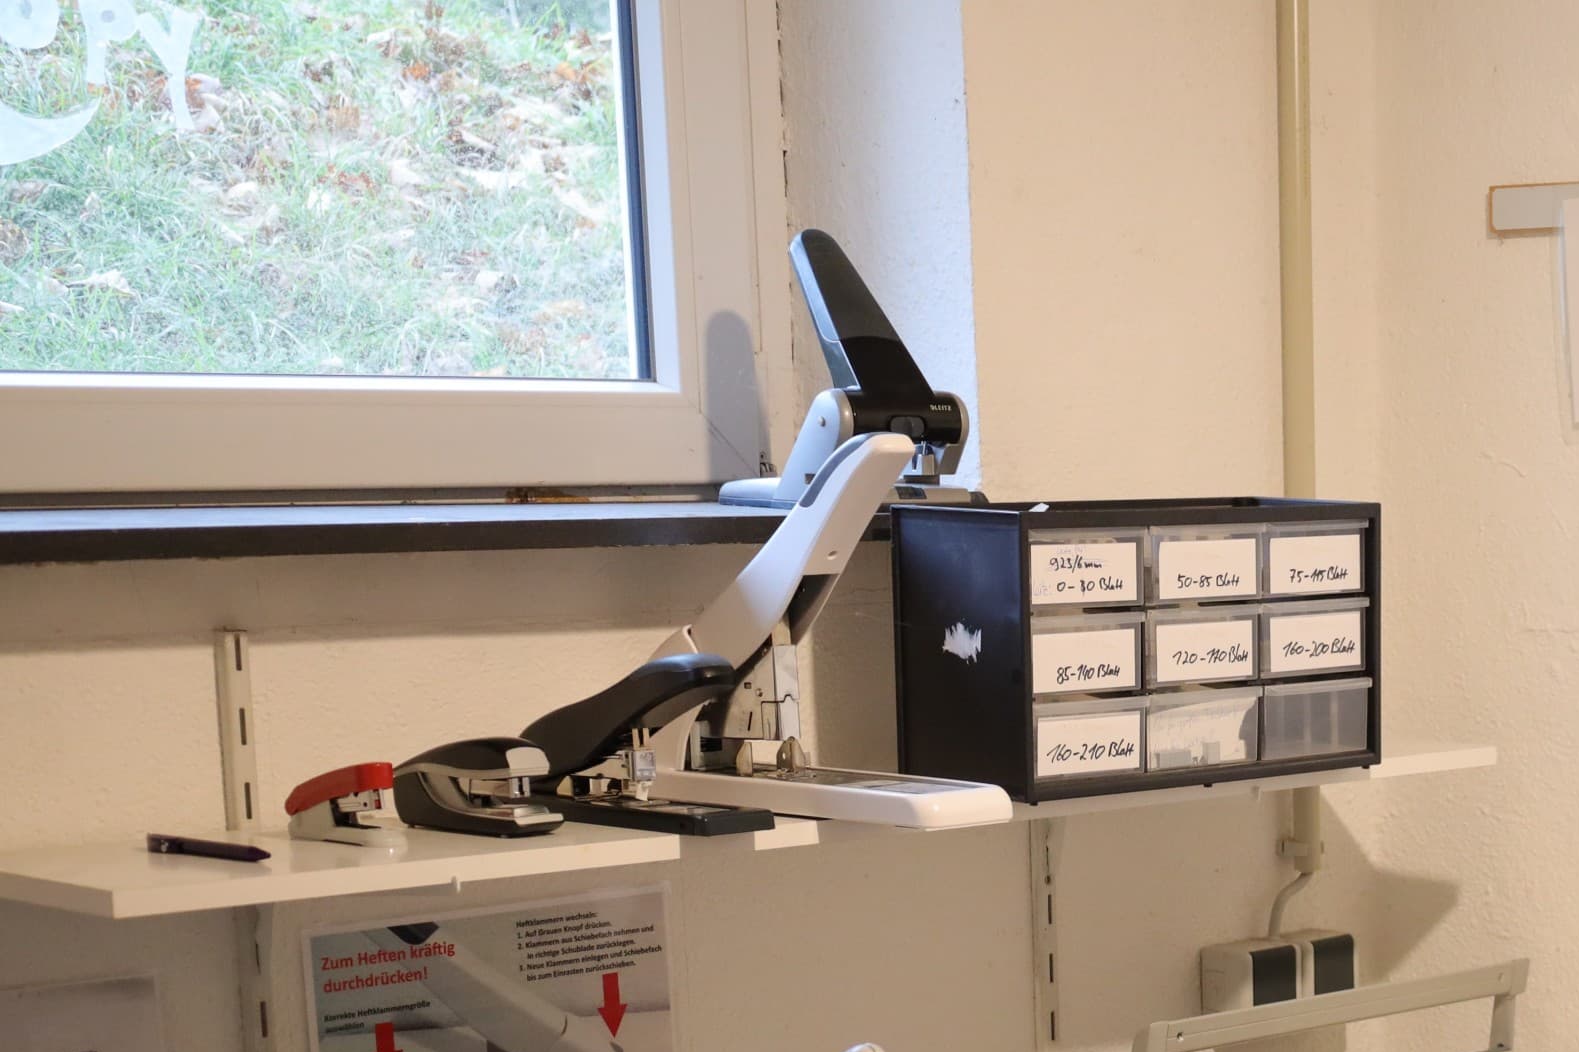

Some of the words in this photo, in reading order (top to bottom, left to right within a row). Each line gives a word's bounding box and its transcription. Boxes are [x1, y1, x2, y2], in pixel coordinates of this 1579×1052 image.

[516, 916, 563, 929] Heftklammern
[525, 929, 537, 938] Auf
[538, 926, 562, 936] Grauen
[564, 923, 584, 934] Knopf
[525, 938, 560, 949] Klammern
[641, 924, 654, 933] und
[321, 956, 353, 971] Zum
[358, 948, 406, 966] Heften
[410, 941, 456, 959] kräftig
[562, 943, 595, 955] Schublade
[527, 962, 545, 971] Neue
[546, 957, 580, 969] Klammern
[610, 950, 623, 959] und
[323, 966, 429, 993] durchdrücken!
[538, 972, 553, 980] zum
[553, 967, 585, 979] Einrasten
[324, 1010, 357, 1023] Korrekte
